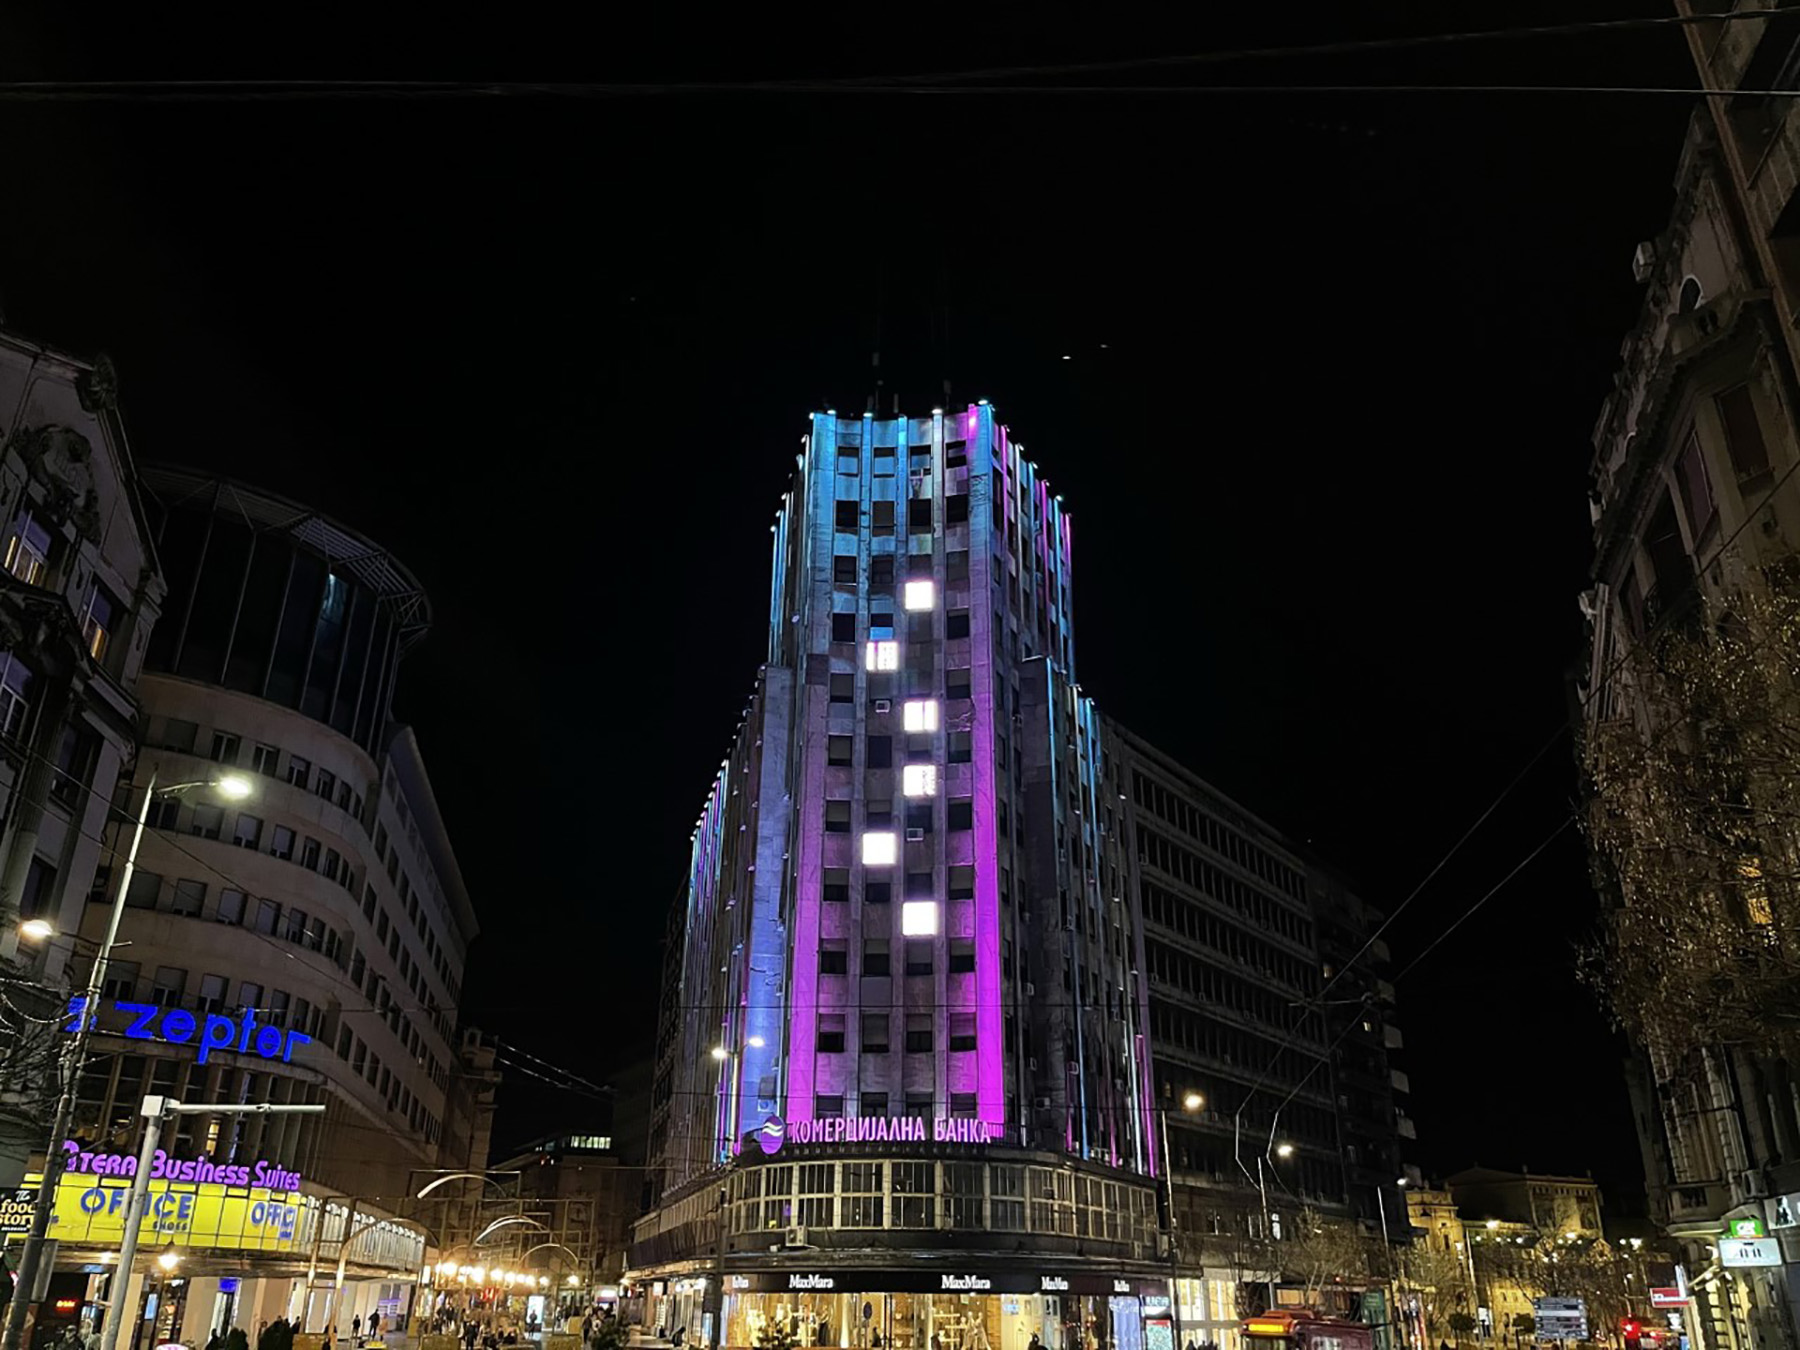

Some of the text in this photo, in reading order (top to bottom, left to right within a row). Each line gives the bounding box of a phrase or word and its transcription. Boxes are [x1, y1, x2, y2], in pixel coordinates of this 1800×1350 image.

[114, 1000, 312, 1065] zepter
[790, 1116, 992, 1144] КОМЕРЦИЈАЛНА БАНКА
[80, 1188, 192, 1220] OFICE
[789, 1273, 834, 1289] MaxMara
[941, 1274, 991, 1290] MaxMara
